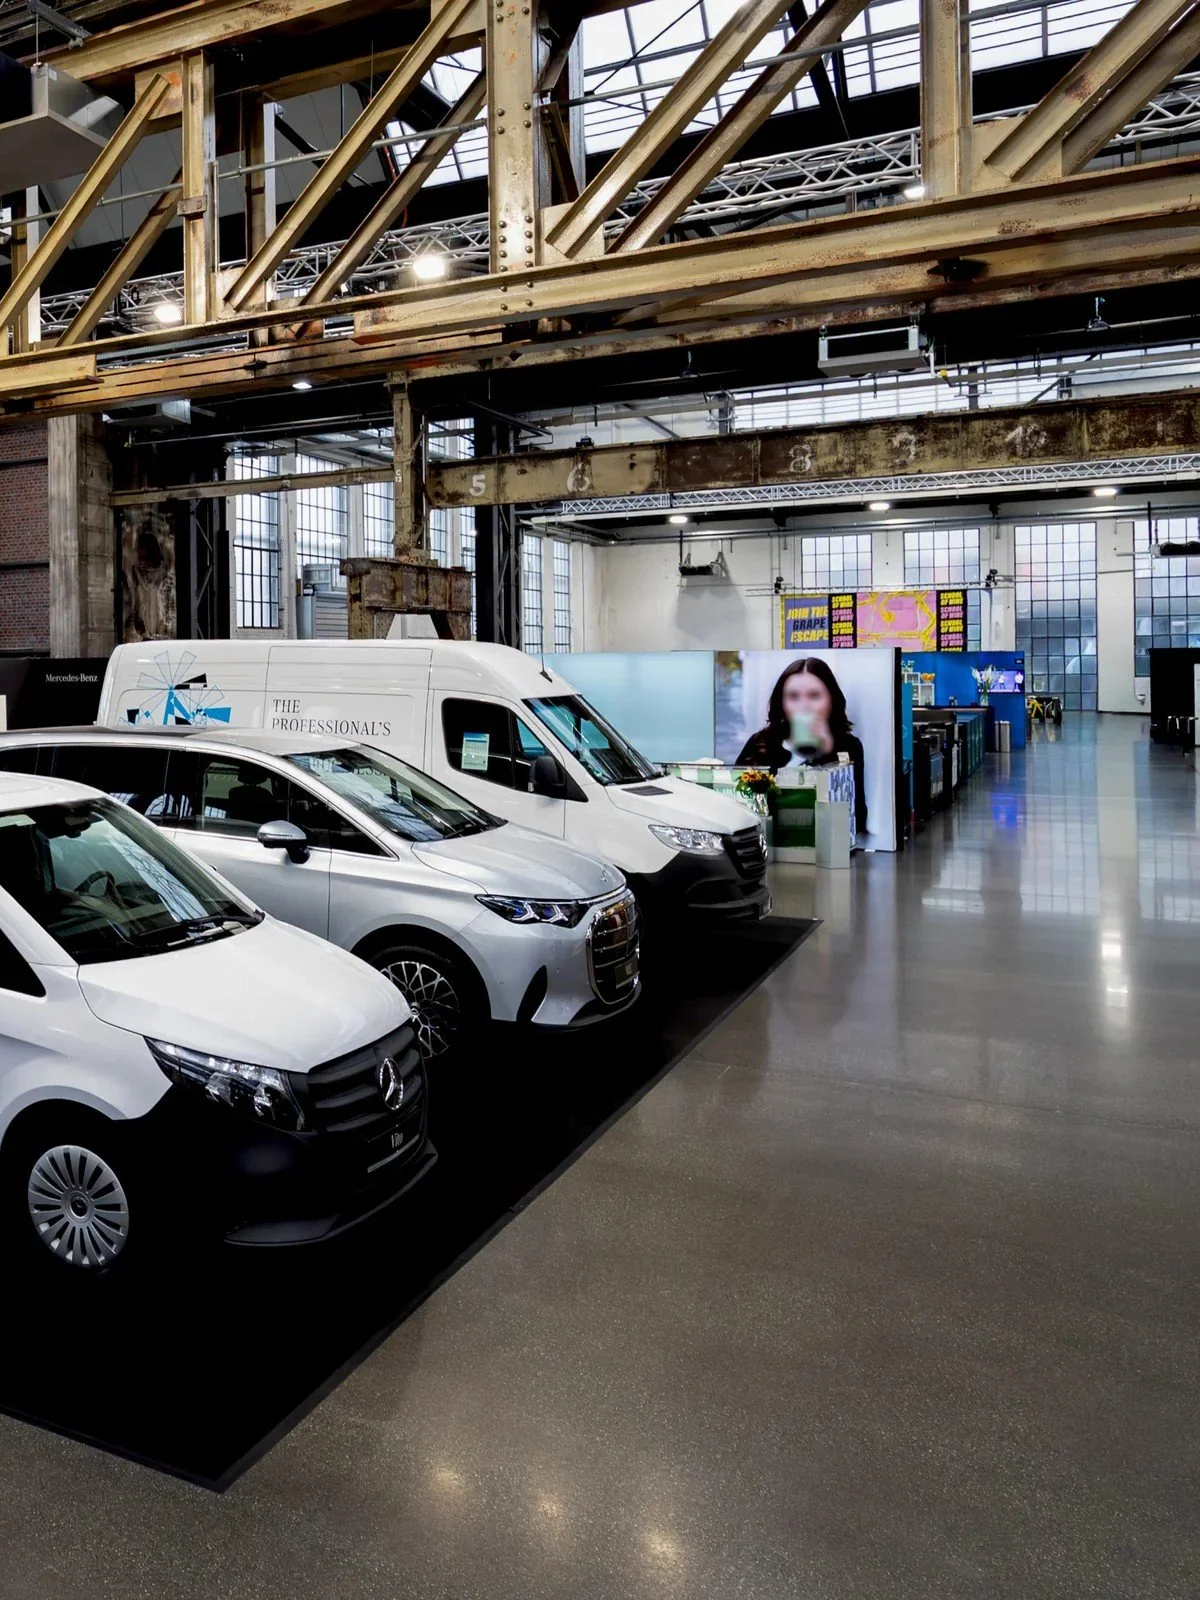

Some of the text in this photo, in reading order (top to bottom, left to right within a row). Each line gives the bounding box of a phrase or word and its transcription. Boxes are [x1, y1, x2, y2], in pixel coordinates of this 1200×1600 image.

[789, 444, 812, 473] 8
[567, 462, 590, 492] 6
[469, 474, 486, 496] 5
[810, 605, 829, 618] THE
[793, 618, 826, 631] GRAPE
[791, 629, 829, 643] ESCAPE
[45, 673, 98, 682] Mercedes-Benz
[273, 699, 300, 713] THE
[272, 718, 391, 736] PROFESSIONAL'S
